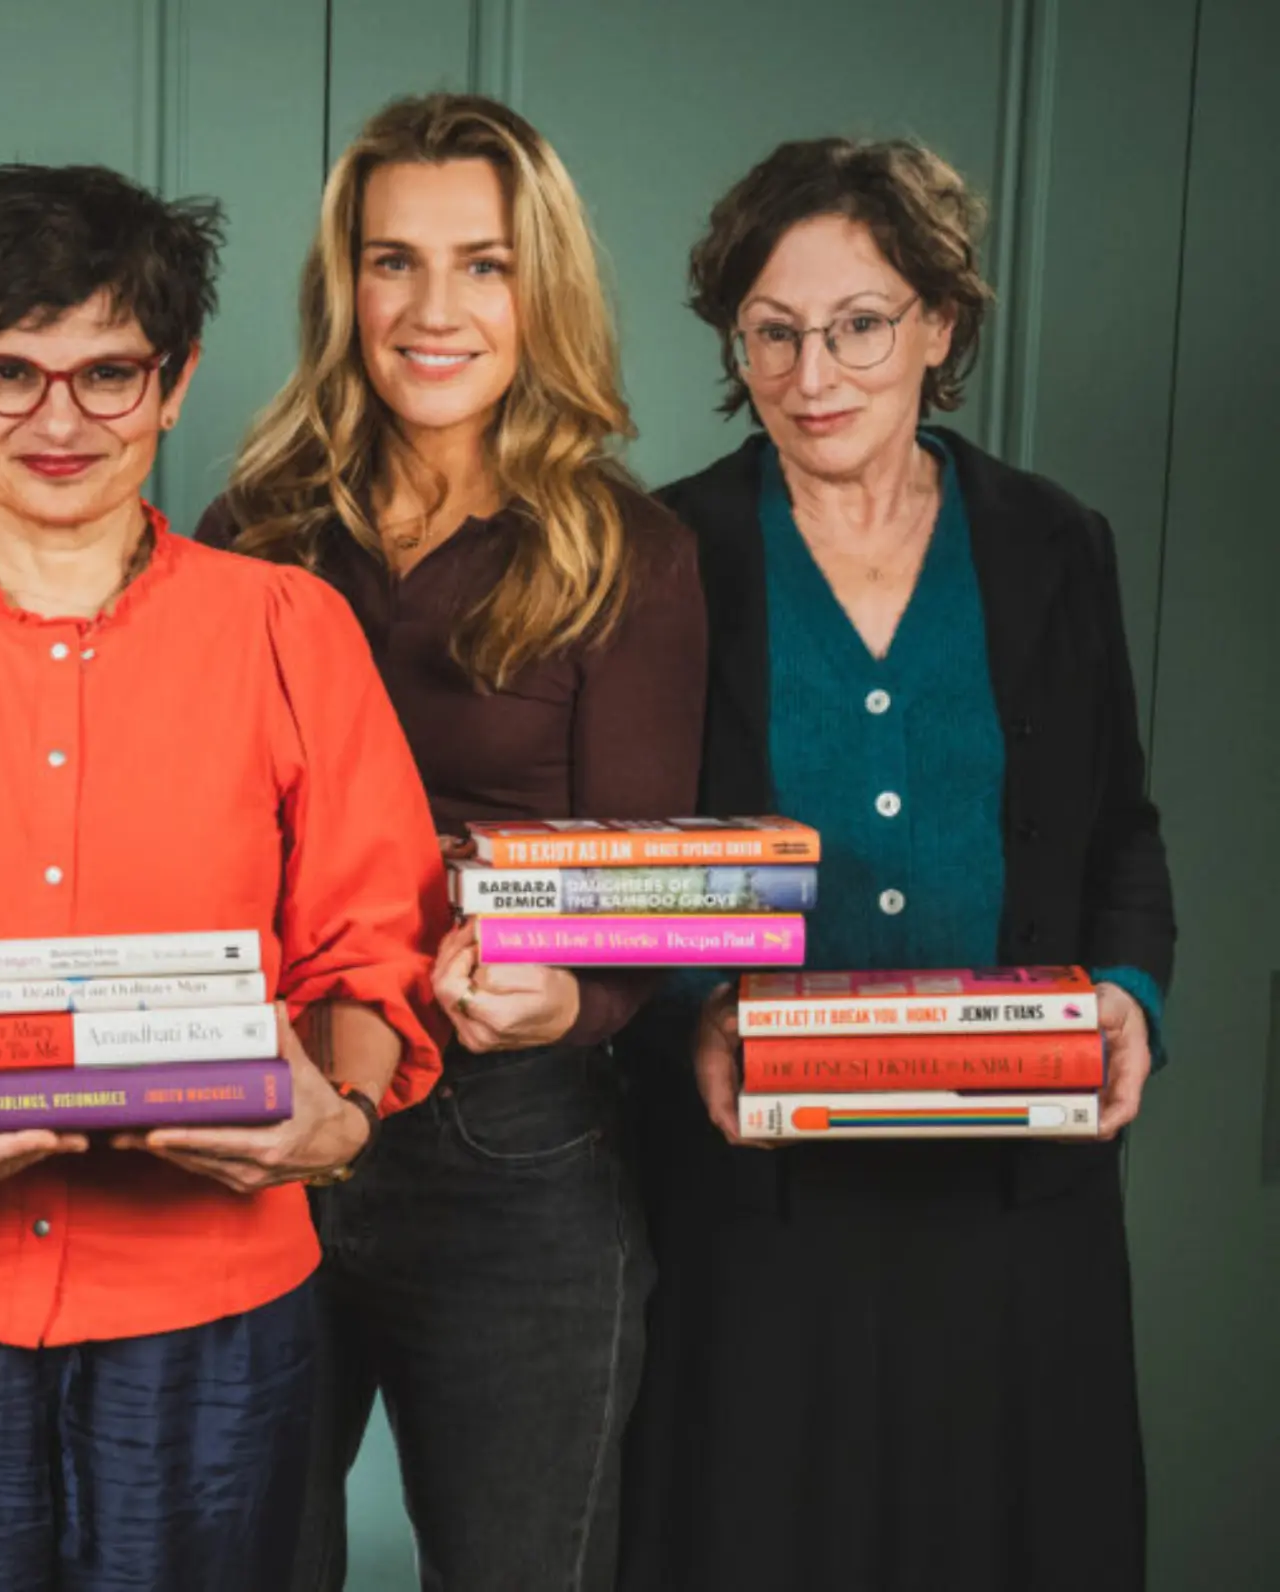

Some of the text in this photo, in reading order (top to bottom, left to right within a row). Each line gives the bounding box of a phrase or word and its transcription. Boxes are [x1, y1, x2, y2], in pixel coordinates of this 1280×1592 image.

[507, 841, 527, 863] TO
[531, 840, 575, 863] EXIST
[579, 840, 599, 862] AS
[610, 839, 633, 860] AM
[478, 879, 557, 894] BARBARA
[670, 878, 692, 893] OF
[494, 895, 556, 909] DEMICK
[723, 930, 755, 949] Paul
[785, 1009, 809, 1027] LET
[813, 1009, 826, 1025] IT
[958, 1003, 1045, 1022] JENNY EVANS
